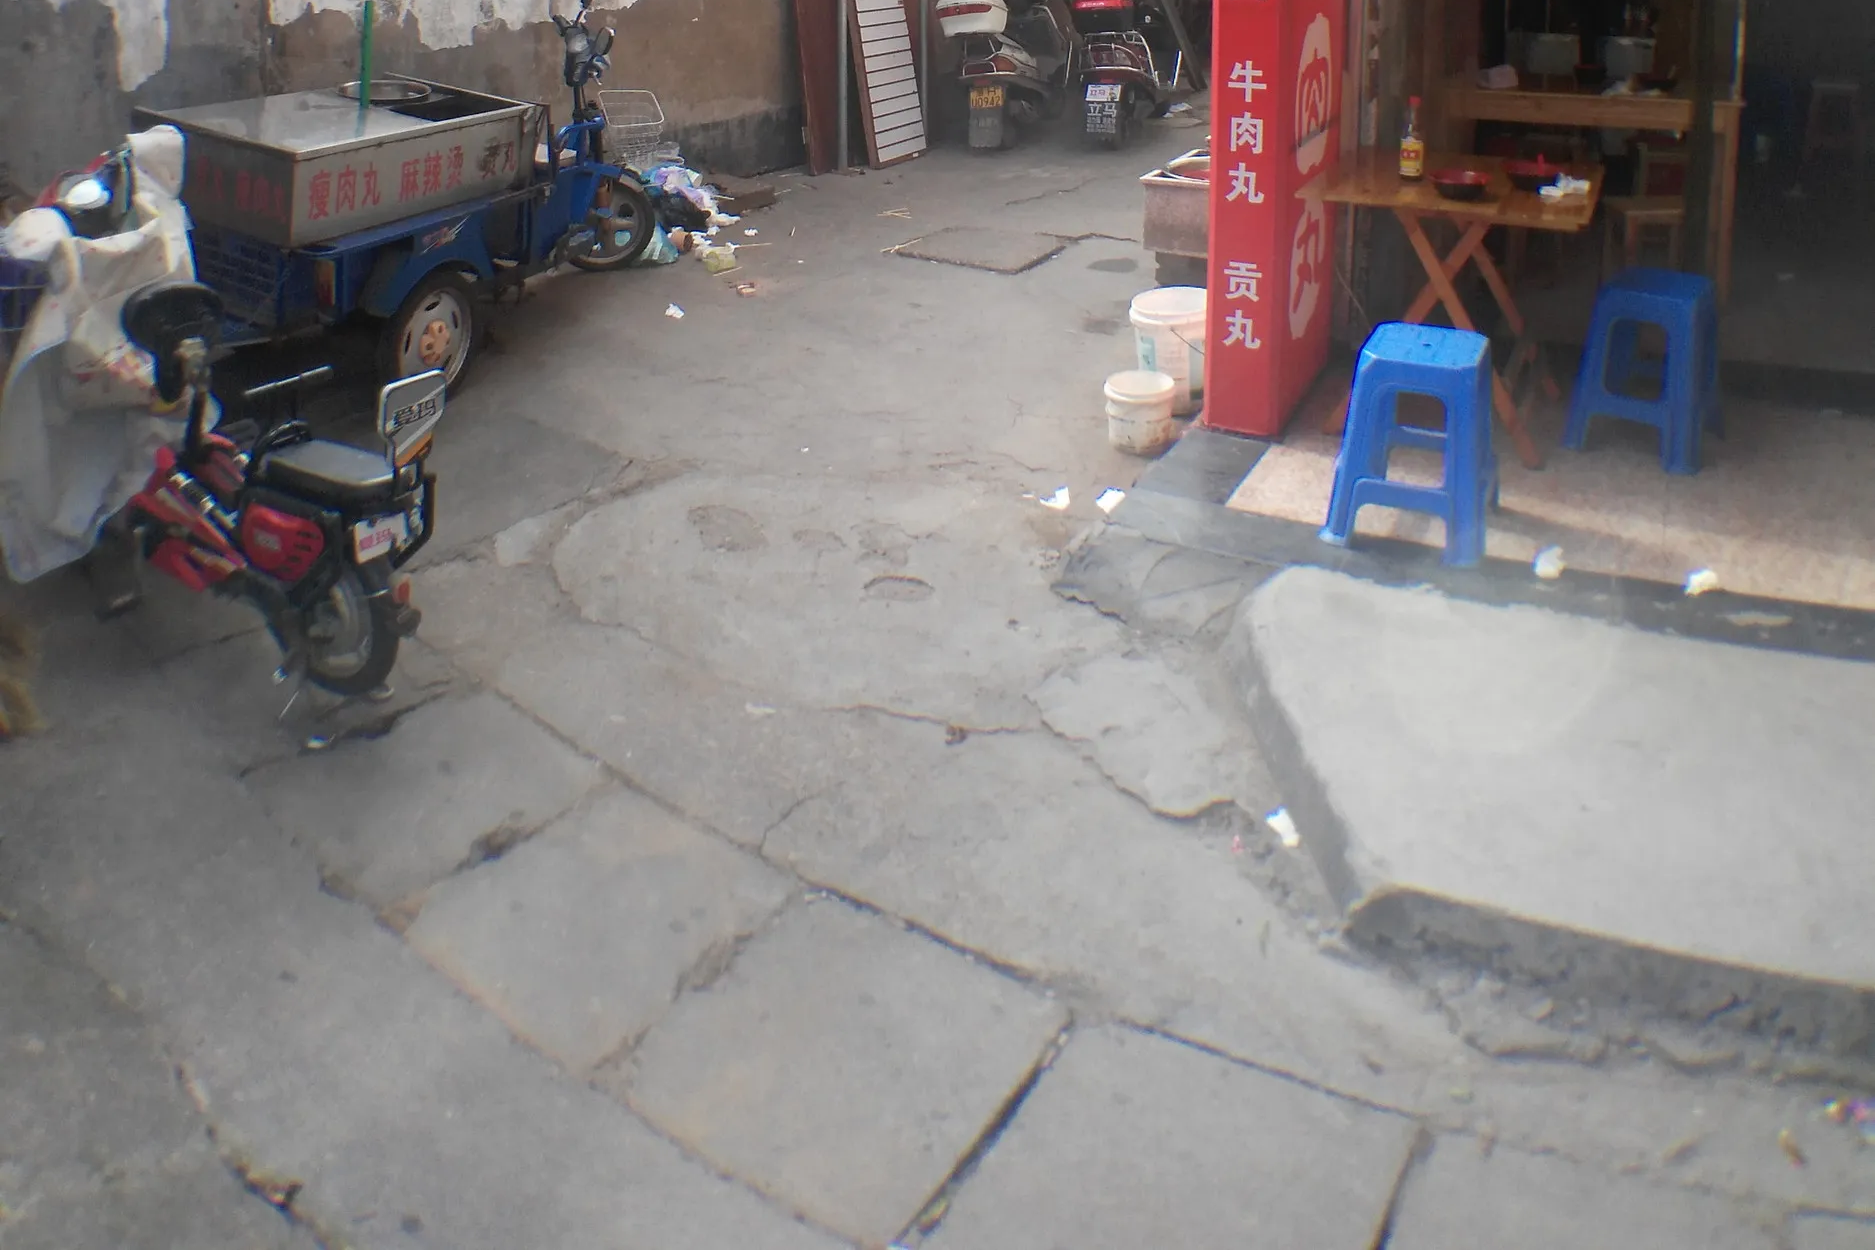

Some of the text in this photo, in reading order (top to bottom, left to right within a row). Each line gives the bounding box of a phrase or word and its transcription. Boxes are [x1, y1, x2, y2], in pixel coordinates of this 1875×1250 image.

[1087, 102, 1117, 118] 立马
[1226, 60, 1267, 204] 牛肉丸
[308, 160, 381, 220] 瘦肉丸
[399, 144, 464, 204] 麻辣烫
[1223, 260, 1262, 350] 贡丸
